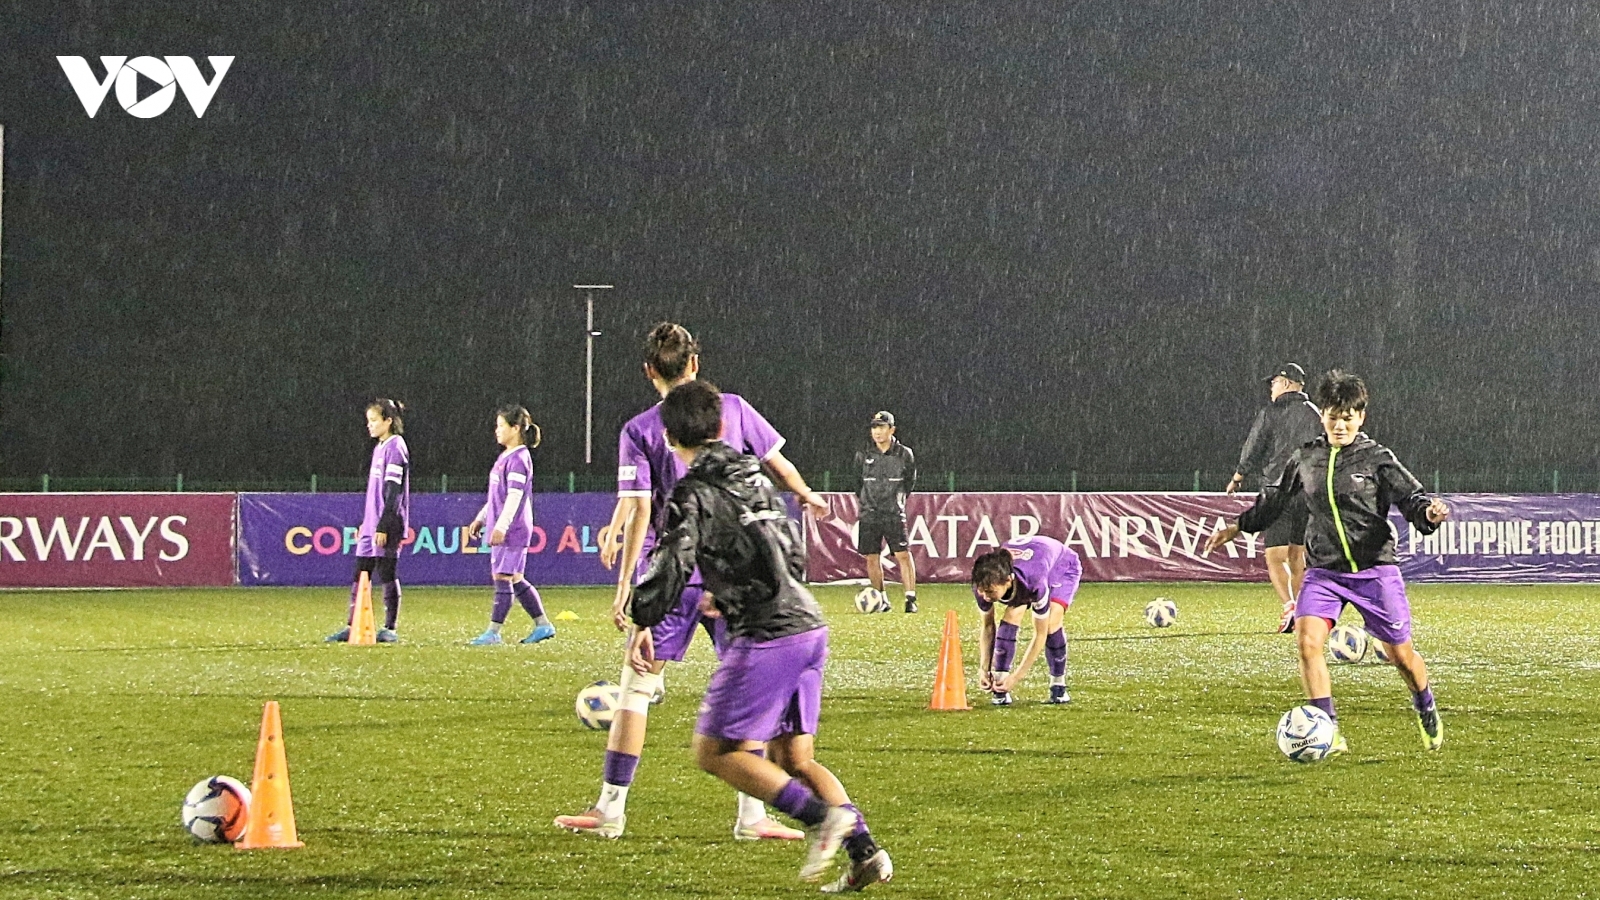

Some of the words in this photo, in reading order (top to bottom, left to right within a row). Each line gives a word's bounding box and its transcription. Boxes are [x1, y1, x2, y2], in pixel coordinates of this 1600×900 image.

[285, 526, 360, 555] COP
[851, 514, 1041, 567] ATA
[1064, 516, 1261, 558] AIRWAY
[1408, 521, 1533, 555] PHILIPPINE
[1538, 521, 1600, 555] FOOT
[1291, 737, 1319, 749] molten
